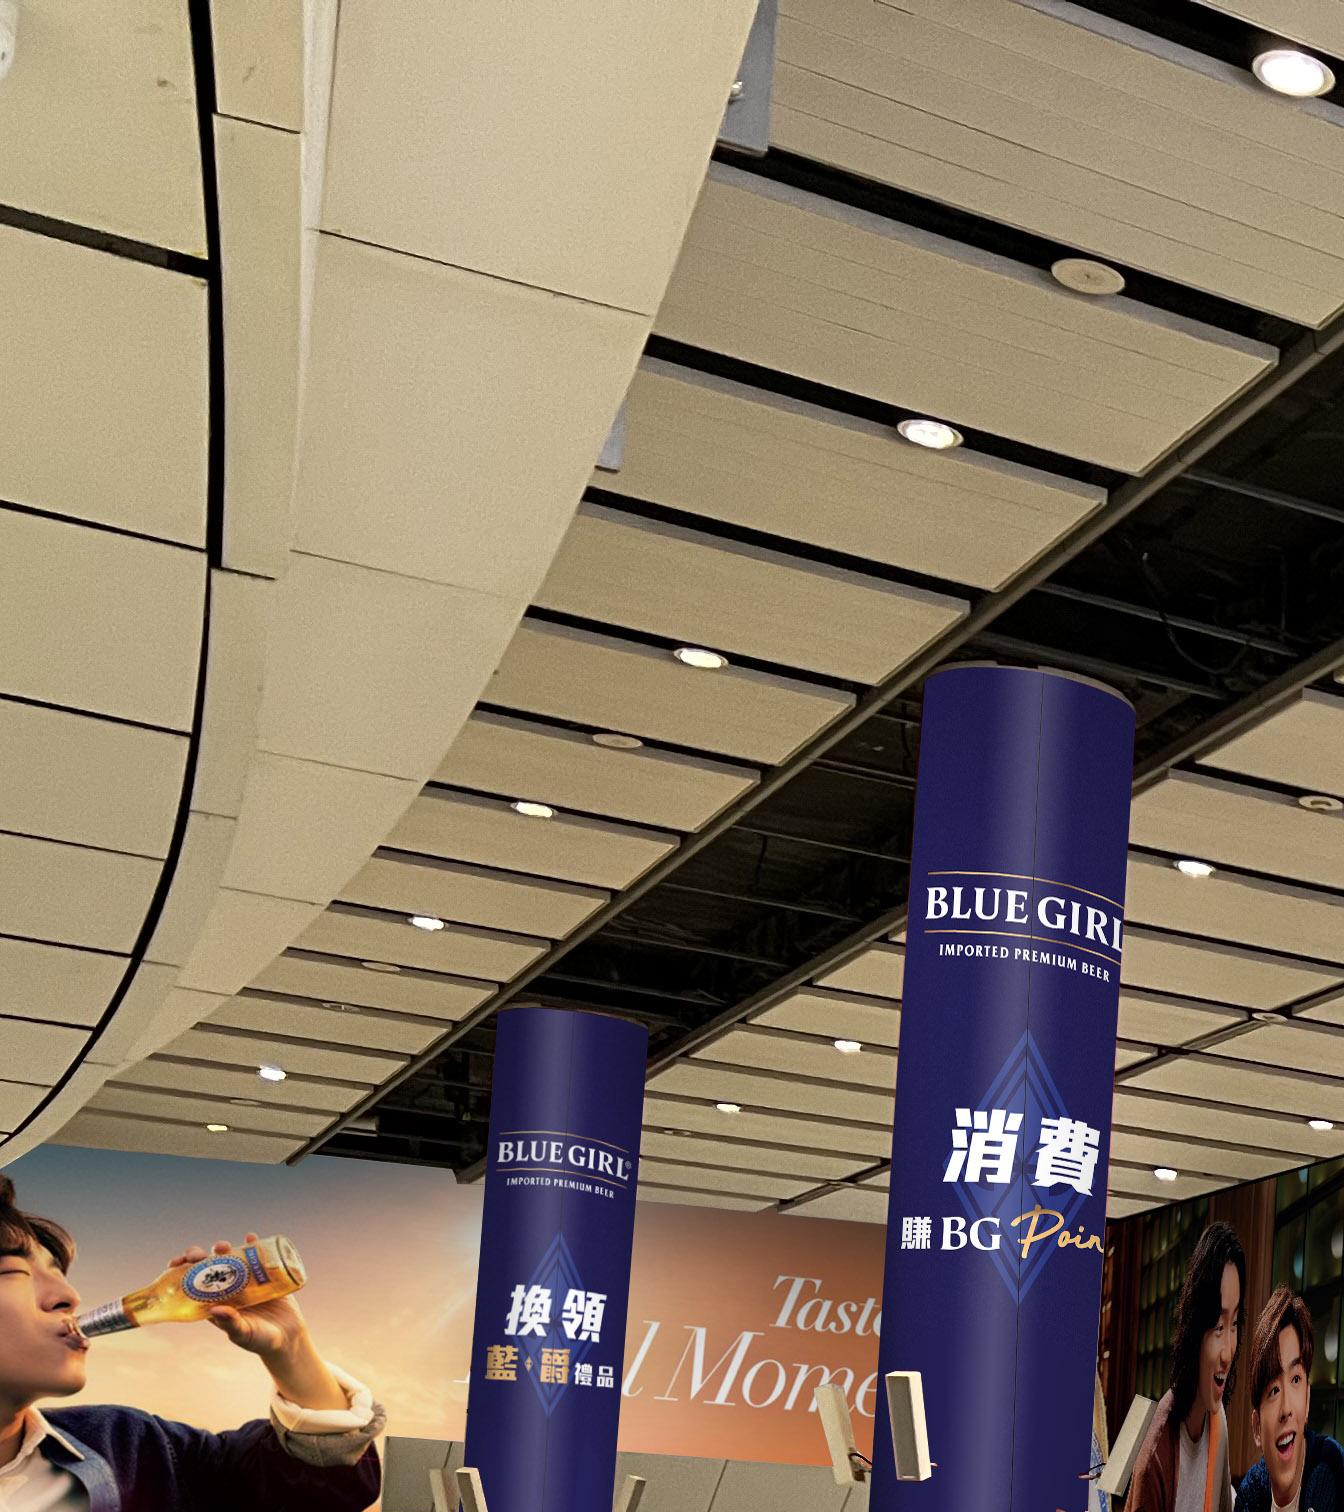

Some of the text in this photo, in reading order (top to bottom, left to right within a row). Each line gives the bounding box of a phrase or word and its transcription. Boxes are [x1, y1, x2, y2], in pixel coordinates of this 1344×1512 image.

[925, 887, 1028, 924] BLUE
[939, 944, 1110, 982] IMPORTED PREMIUM BEER
[497, 1141, 563, 1163] BLUE
[943, 1108, 1101, 1196] 消費
[507, 1177, 614, 1199] IMPORTED PREMIUM BEER
[901, 1216, 932, 1250] 賺
[941, 1216, 1001, 1251] BG
[504, 1284, 607, 1342] 換領
